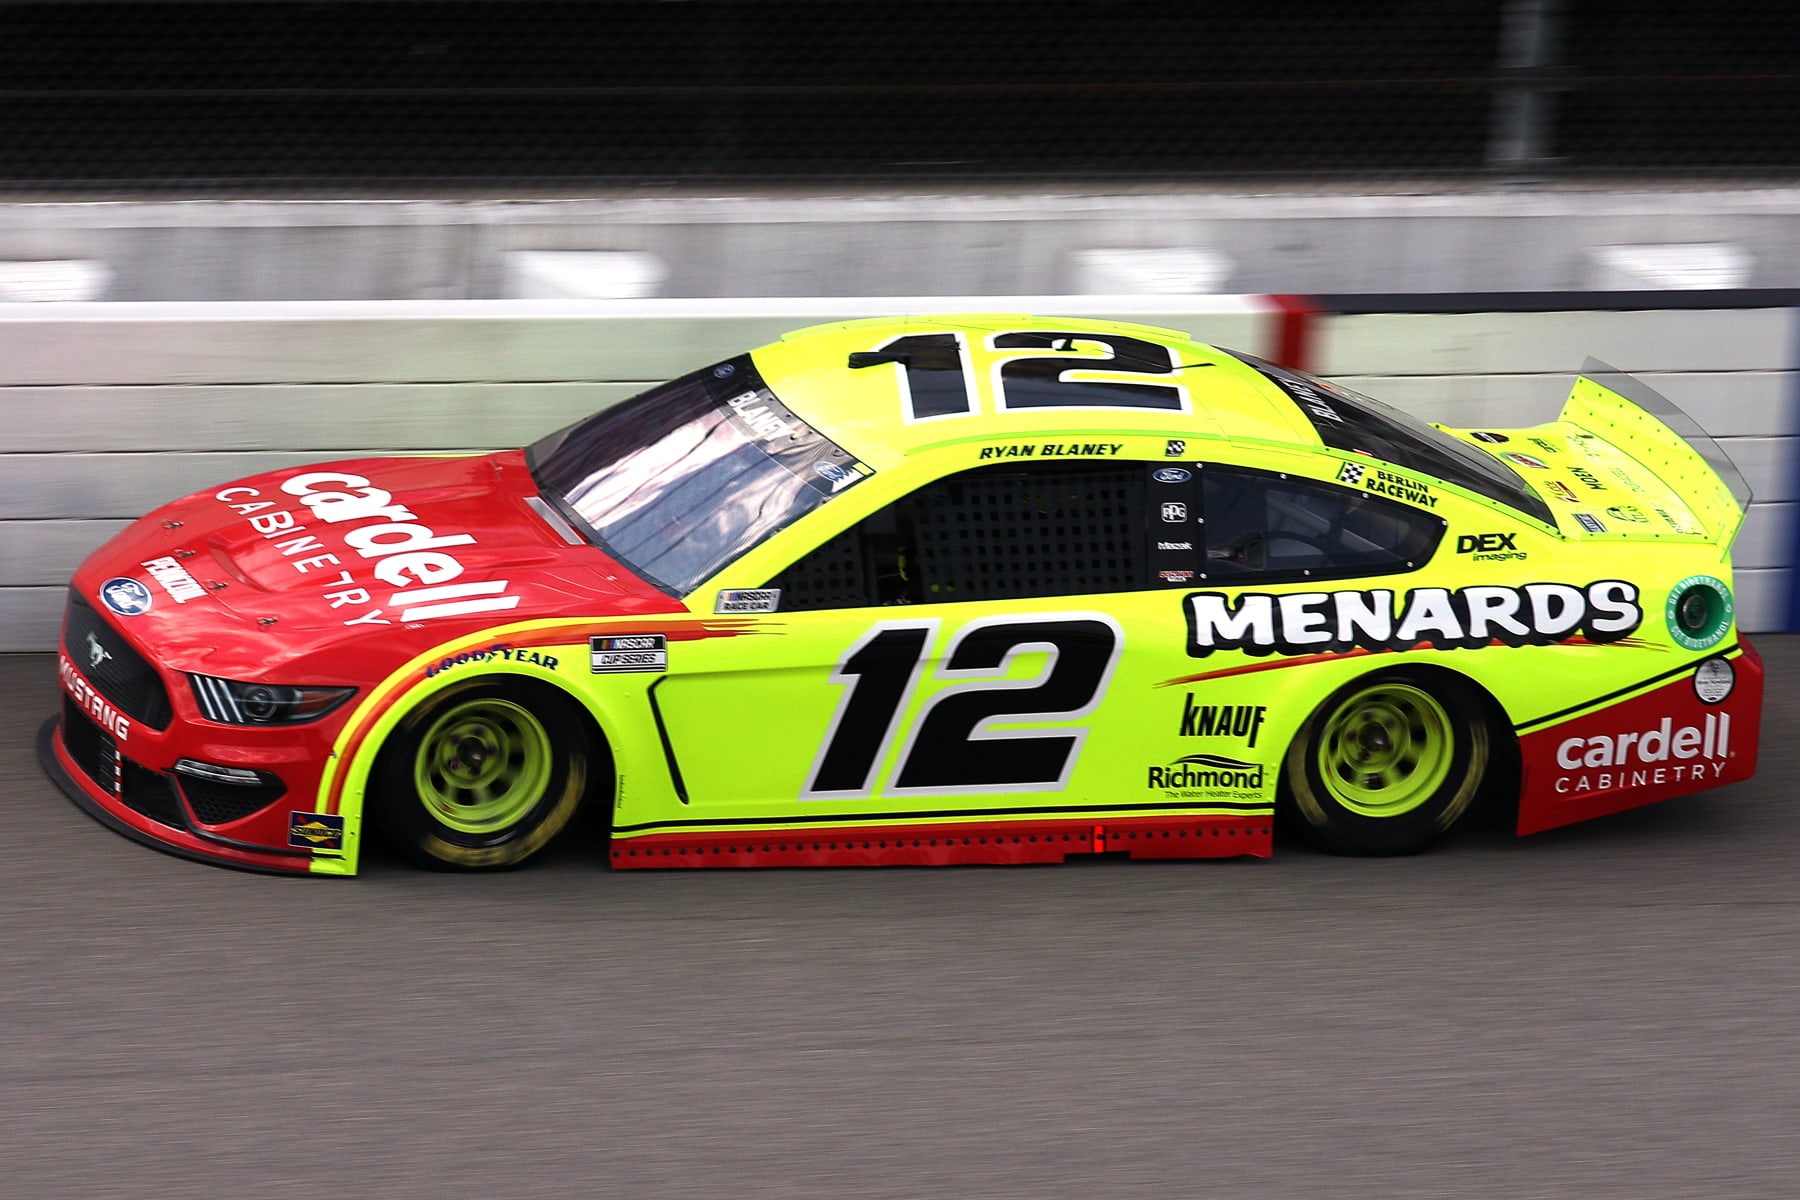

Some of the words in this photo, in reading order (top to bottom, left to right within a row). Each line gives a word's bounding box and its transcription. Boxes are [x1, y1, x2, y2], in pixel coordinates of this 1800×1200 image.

[878, 330, 1193, 425] 12
[727, 390, 795, 441] BLANEY
[979, 444, 1036, 460] RYAN
[1040, 443, 1123, 456] BLANEY
[1156, 469, 1189, 481] Ford
[1377, 471, 1428, 493] BERLIN
[1366, 478, 1438, 508] RACEWAY
[1162, 504, 1187, 520] PPG
[216, 486, 391, 626] CABINETRY
[280, 472, 520, 623] cardell
[1457, 532, 1517, 554] DEX
[1472, 551, 1528, 562] imaging
[140, 556, 208, 604] PENNZOIL
[104, 583, 148, 610] Ford
[723, 602, 748, 611] RACE
[749, 601, 770, 611] CAR
[1186, 580, 1642, 654] MENARDS
[612, 638, 656, 650] NASCAR
[426, 648, 559, 678] GOODYEAR
[600, 653, 621, 665] CUP
[622, 653, 657, 665] SERIES
[60, 655, 131, 741] MUSTANG
[799, 612, 1124, 800] 12
[1556, 711, 1730, 770] cardell
[1148, 763, 1264, 789] Richmond
[1555, 762, 1726, 793] CABINETRY
[1165, 791, 1179, 799] The
[1181, 791, 1203, 799] Water
[1205, 791, 1231, 799] Heater
[1232, 791, 1264, 800] Experts
